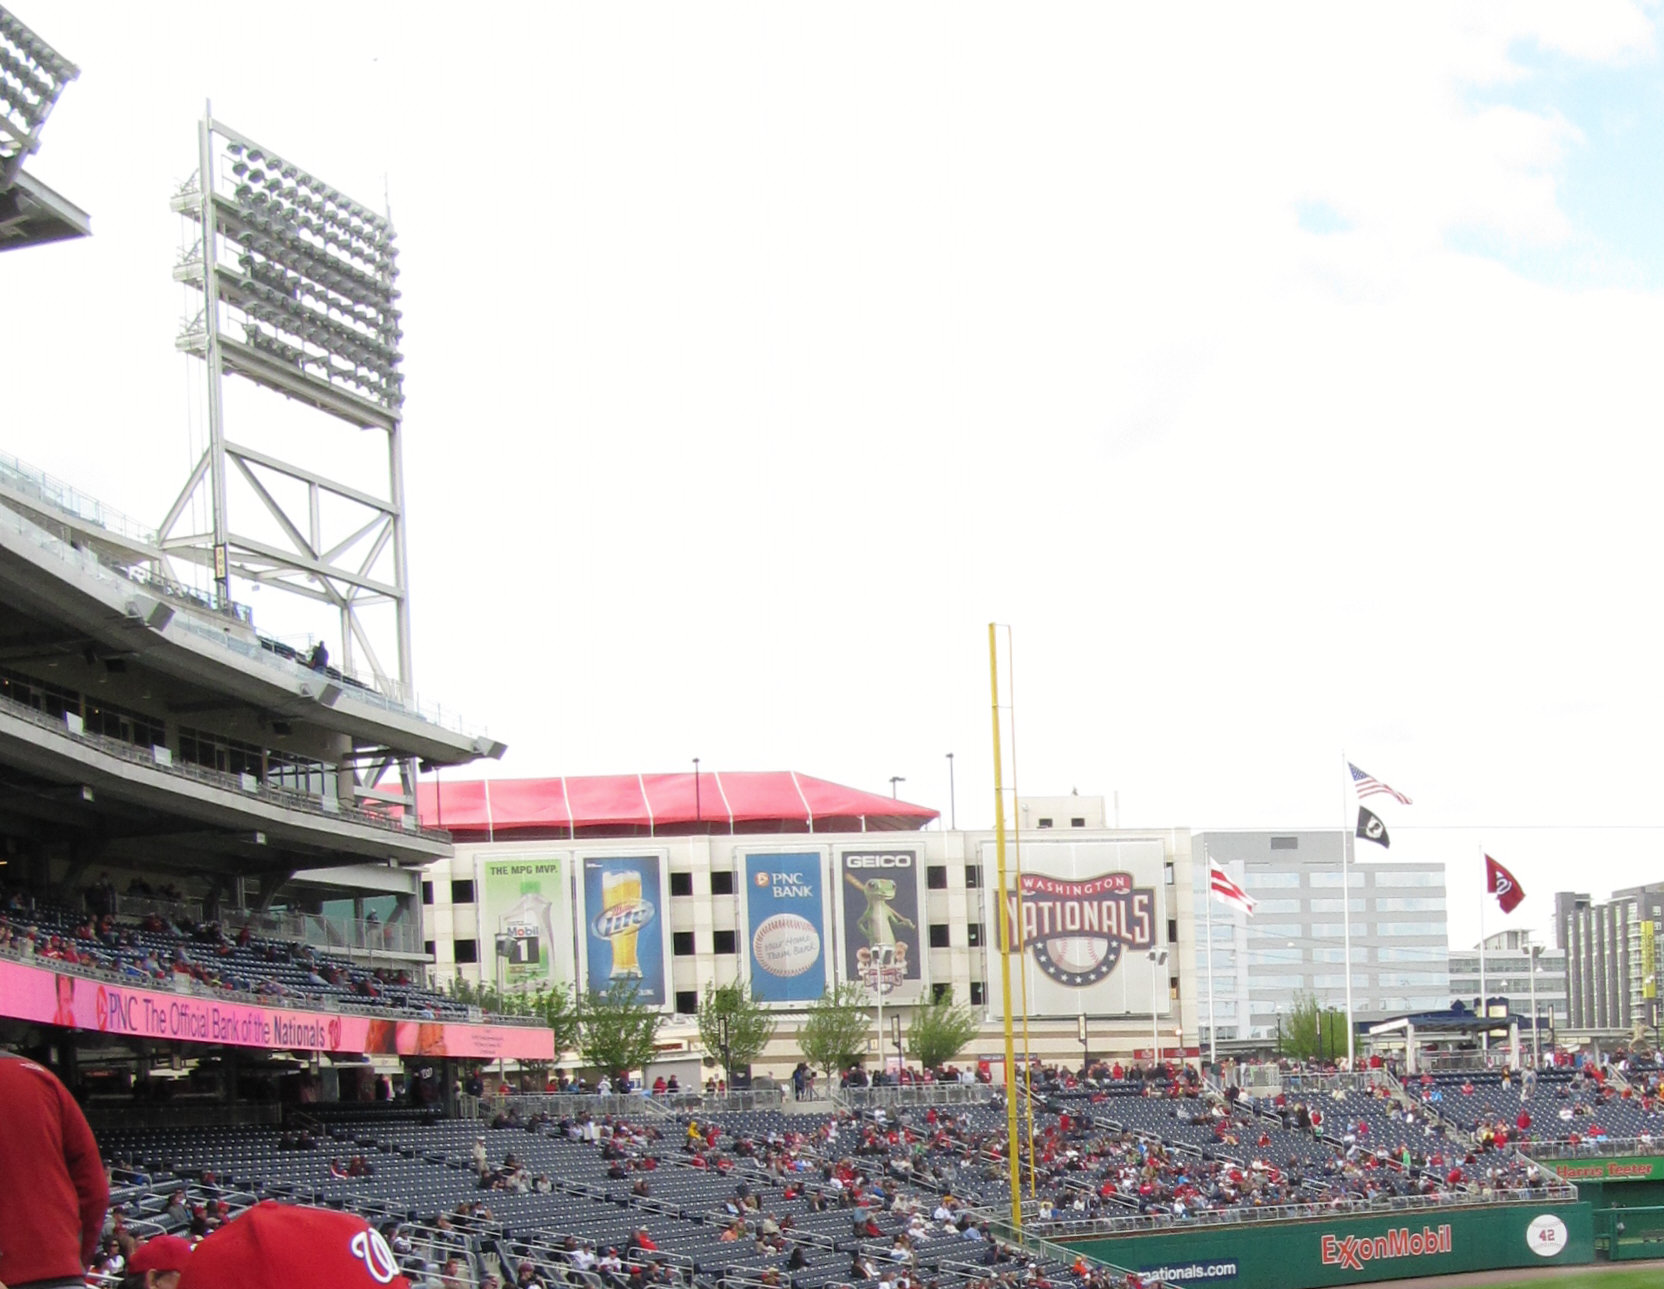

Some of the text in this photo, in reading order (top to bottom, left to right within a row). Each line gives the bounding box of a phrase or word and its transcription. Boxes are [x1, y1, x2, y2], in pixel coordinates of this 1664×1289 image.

[846, 855, 911, 868] GEICO
[490, 867, 508, 876] THE
[511, 866, 533, 875] MPG
[772, 873, 804, 884] PNC
[773, 886, 813, 898] BANK
[1023, 877, 1126, 896] WASHINGTON
[1006, 895, 1150, 946] NATIONALS
[507, 926, 539, 937] Mobil
[517, 939, 528, 962] 1
[108, 992, 325, 1047] PNC The Official Bank of the Nationals
[1556, 1162, 1653, 1178] Harris Teeter
[1538, 1229, 1555, 1243] 42
[1320, 1224, 1452, 1270] ExxonMobil
